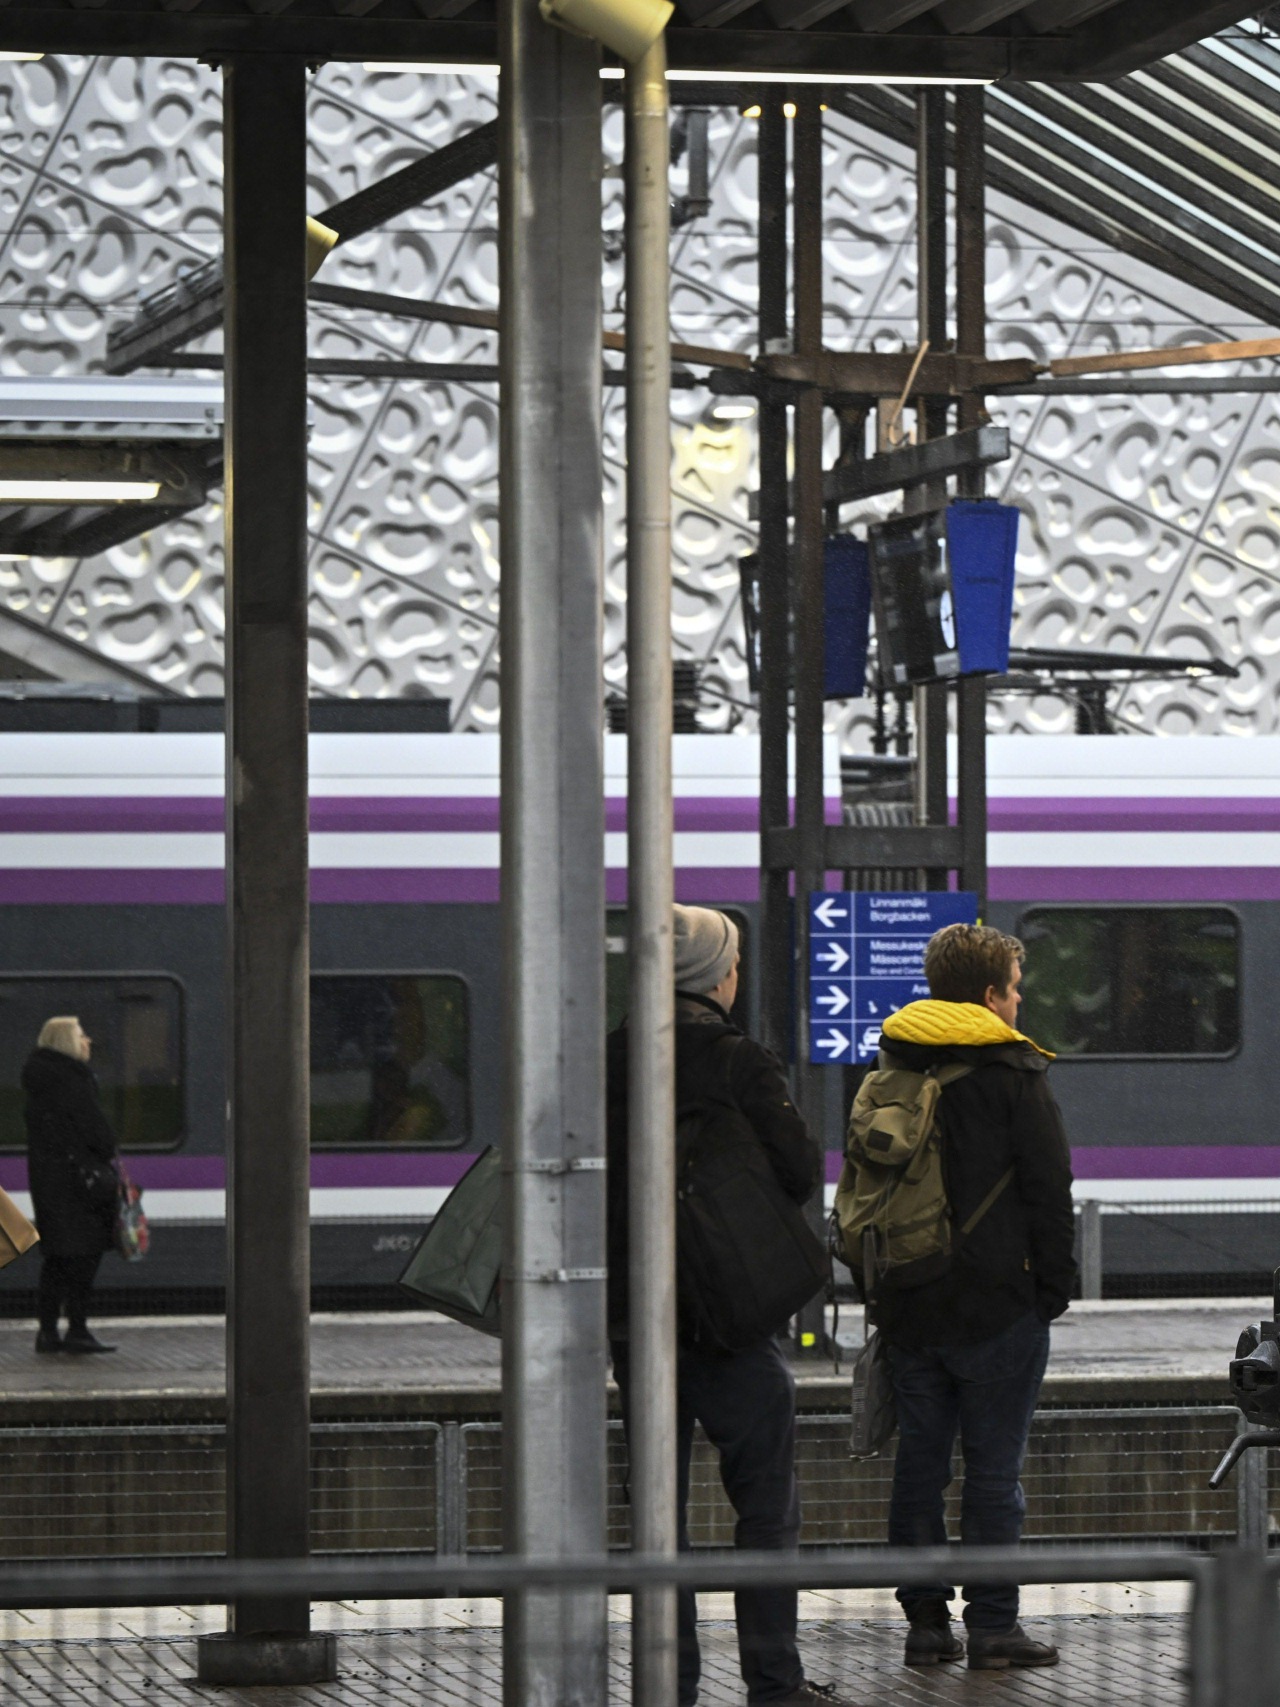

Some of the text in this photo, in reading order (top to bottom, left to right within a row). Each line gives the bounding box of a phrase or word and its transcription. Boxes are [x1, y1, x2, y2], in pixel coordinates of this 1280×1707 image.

[870, 897, 926, 908] Linnanmäki
[870, 910, 930, 924] Borgbacken
[870, 940, 927, 951] Messukesk
